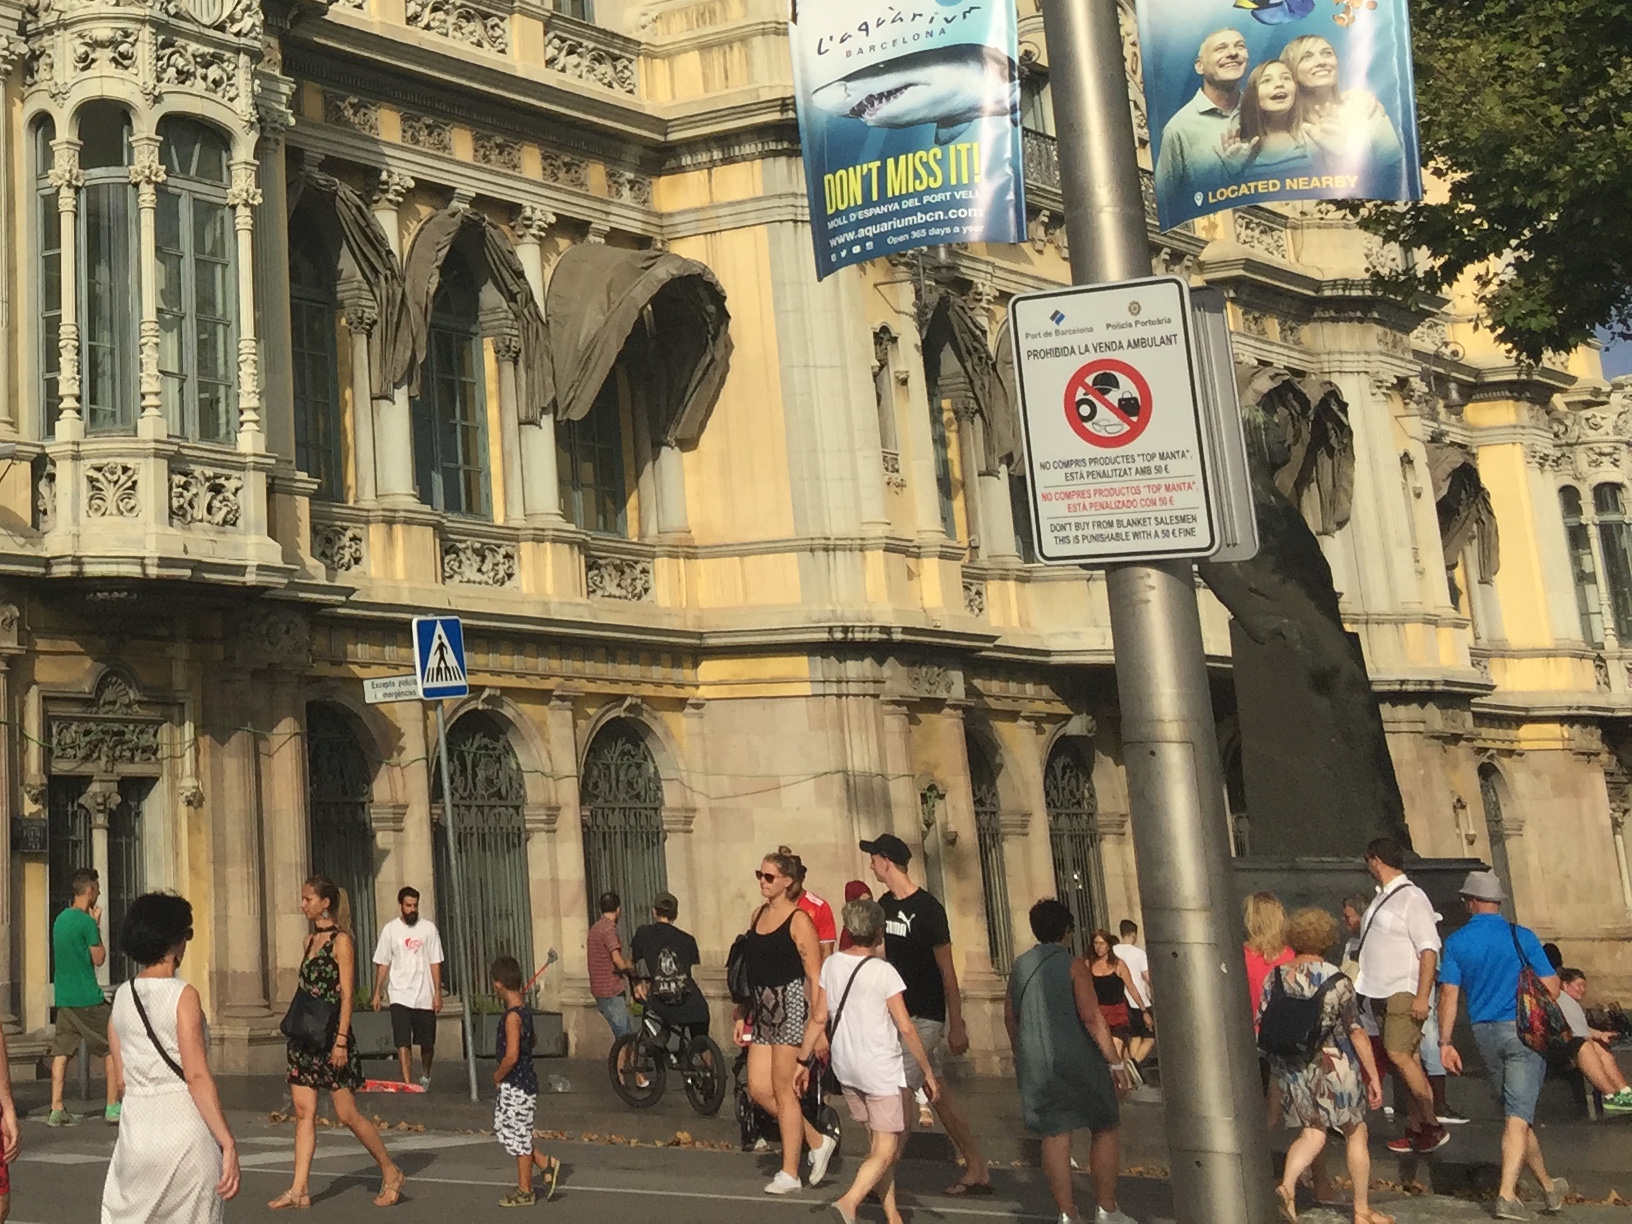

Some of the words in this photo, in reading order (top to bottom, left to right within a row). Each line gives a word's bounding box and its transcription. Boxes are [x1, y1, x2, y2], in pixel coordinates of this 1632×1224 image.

[845, 28, 946, 58] BARCELONA
[824, 160, 881, 215] DON'T
[886, 148, 942, 198] MISS
[949, 142, 980, 185] IT!
[1208, 179, 1281, 203] LOCATED
[1286, 175, 1358, 190] NEARBY
[827, 216, 848, 229] MOLL
[850, 202, 900, 221] D'ESPANYA
[902, 199, 921, 209] DEL
[923, 193, 951, 204] PORT
[829, 207, 983, 247] www.aquariumbcn.com
[887, 233, 909, 245] Open
[911, 229, 926, 239] 365
[929, 227, 950, 238] days
[962, 225, 983, 235] year
[1055, 327, 1093, 337] Barcelona
[1027, 345, 1076, 360] PROHIBIDA
[1078, 344, 1090, 355] LA
[1092, 340, 1124, 352] VENDA
[1127, 334, 1177, 350] AMBULANT
[1040, 462, 1051, 470] NO
[1053, 459, 1087, 469] COMPRIS
[1089, 455, 1135, 466] PRODUCTES
[1086, 468, 1132, 479] PENALITZAT
[1135, 466, 1152, 475] AMB
[1155, 466, 1162, 474] 50
[1164, 465, 1169, 474] €
[1042, 492, 1052, 502] NO
[1054, 489, 1091, 500] COMPRES
[1094, 486, 1141, 498] PRODUCTOS
[1089, 499, 1137, 510] PENALIZADO
[1140, 497, 1157, 507] CON
[1169, 496, 1174, 505] €
[1050, 523, 1073, 532] DON'T
[1075, 522, 1090, 531] BUY
[1092, 520, 1114, 530] FROM
[1116, 517, 1152, 528] BLANKET
[1154, 514, 1197, 525] SALESMEN
[1054, 536, 1071, 545] THIS
[1073, 535, 1079, 543] IS
[1082, 532, 1130, 543] PUNISHABLE
[1132, 530, 1151, 540] WITH
[1154, 530, 1160, 538] A
[1162, 529, 1170, 538] 50
[1179, 527, 1196, 537] FINE
[885, 920, 907, 937] UMA
